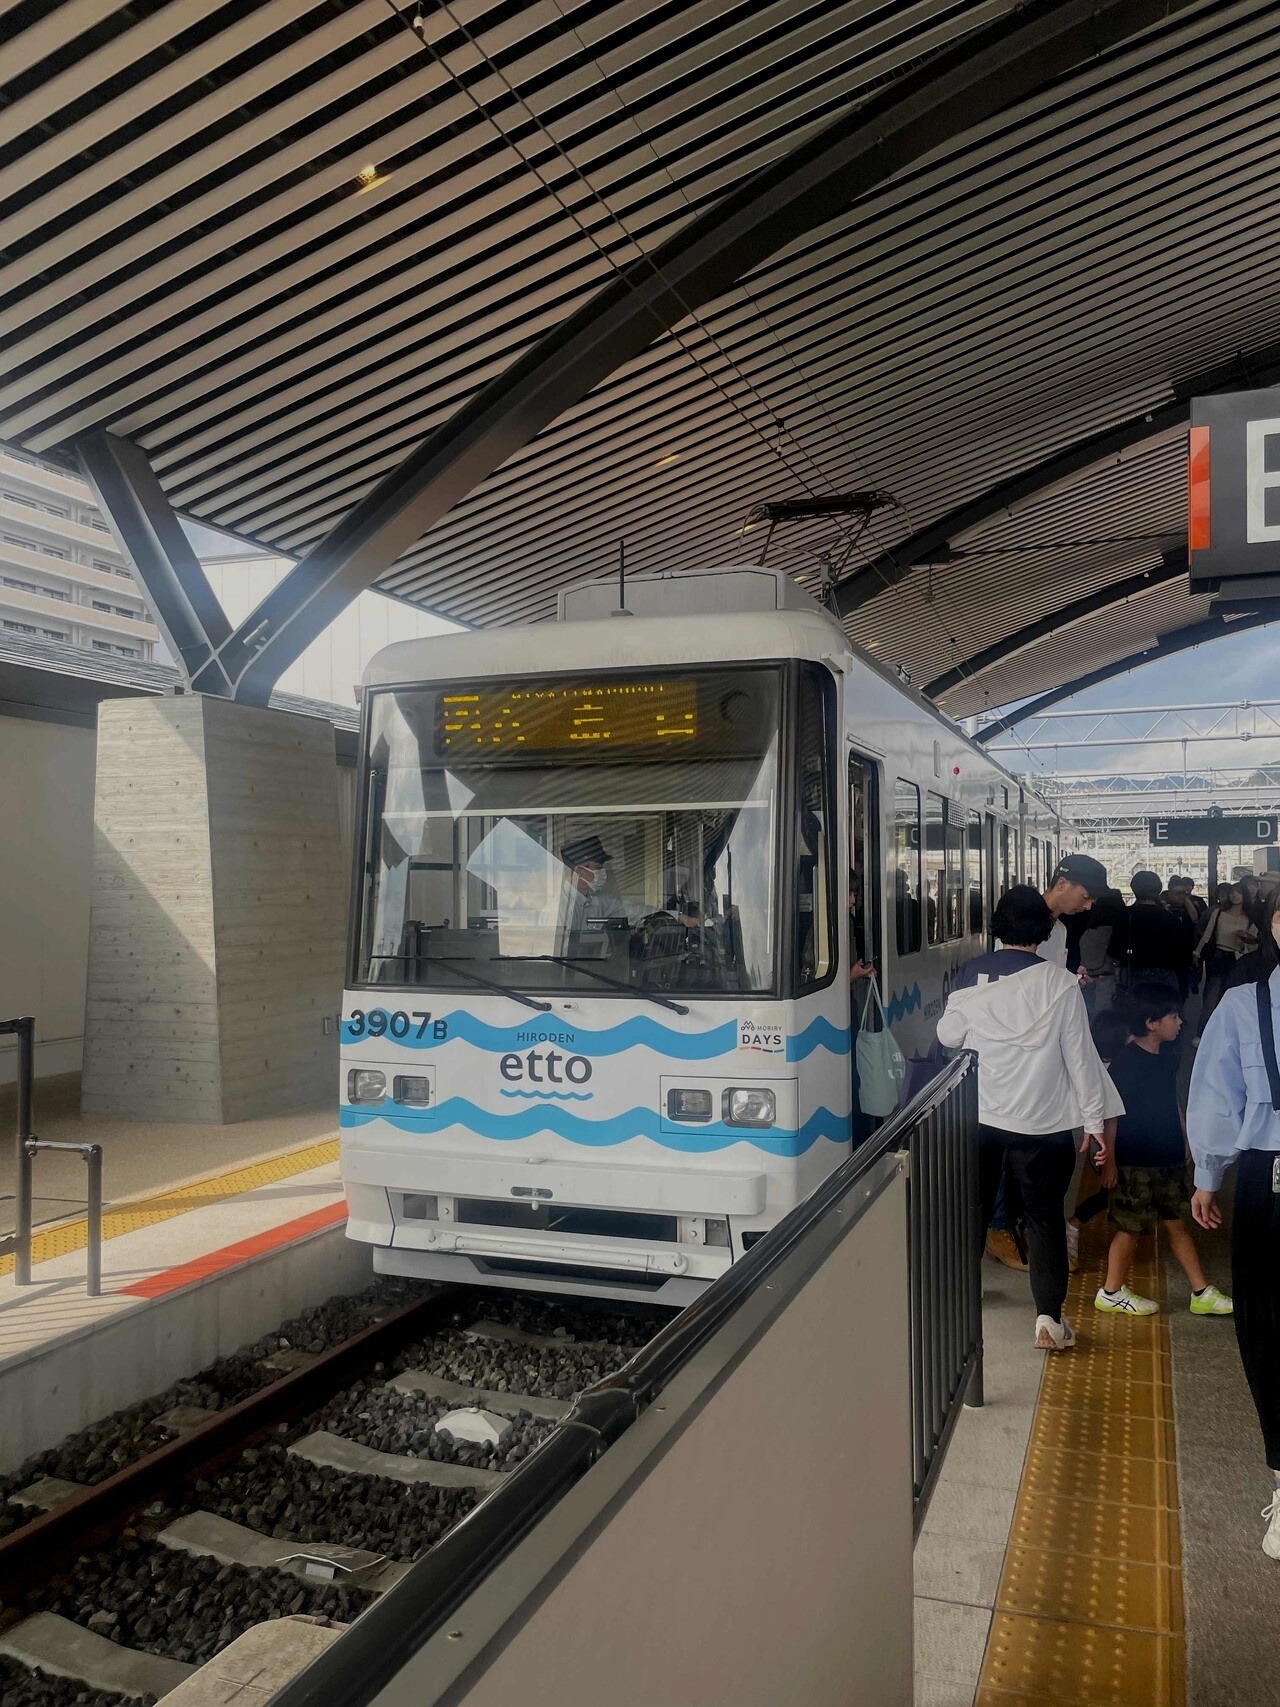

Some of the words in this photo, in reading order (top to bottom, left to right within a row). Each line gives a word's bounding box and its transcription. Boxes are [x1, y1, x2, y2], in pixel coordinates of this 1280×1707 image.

[1156, 822, 1169, 839] E
[1256, 820, 1271, 838] D
[517, 1032, 575, 1043] HIRODEN
[742, 1034, 782, 1045] DAYS
[500, 1049, 592, 1084] etto
